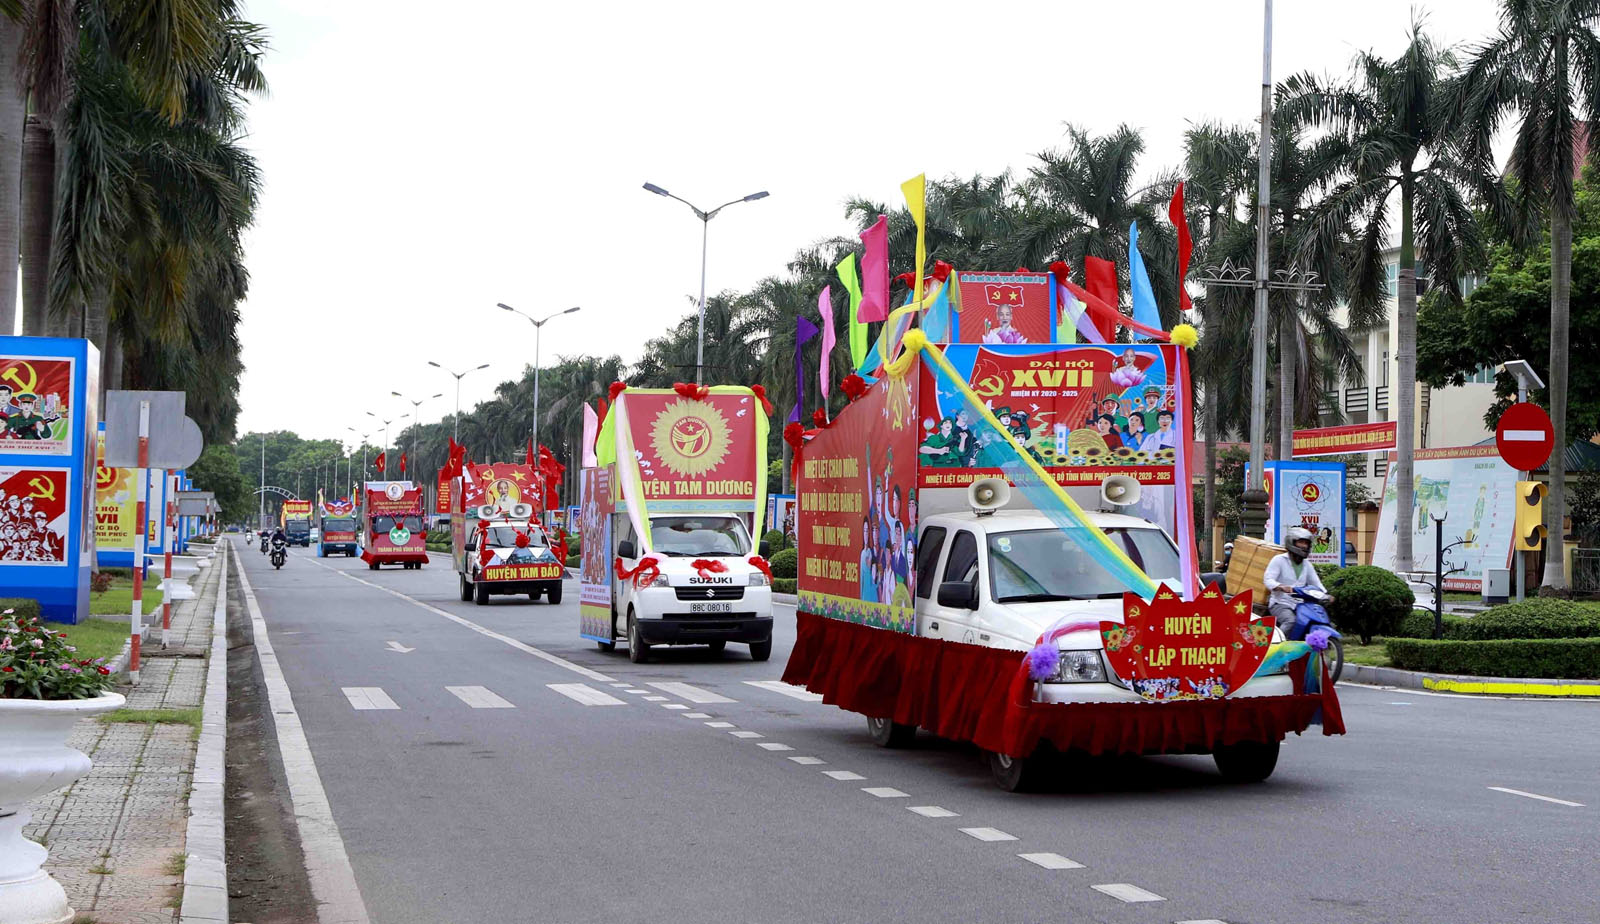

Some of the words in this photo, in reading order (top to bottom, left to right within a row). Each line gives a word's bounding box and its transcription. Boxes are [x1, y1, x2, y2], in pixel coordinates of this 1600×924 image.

[1029, 361, 1060, 370] ĐẠI
[1065, 359, 1094, 370] HỘI
[1011, 369, 1094, 388] XVII
[1010, 390, 1030, 398] NHIỆM
[676, 418, 688, 428] TAM
[804, 456, 818, 483] NHIỆT
[818, 456, 828, 483] LIỆT
[828, 455, 842, 479] CHÀO
[843, 454, 858, 479] MỪNG
[926, 473, 942, 486] NHIỆT
[944, 473, 956, 486] LIỆT
[957, 472, 973, 483] CHÀO
[1056, 471, 1064, 483] BỘ
[1066, 470, 1079, 481] TỈNH
[1080, 471, 1094, 481] VĨNH
[1138, 472, 1152, 480] 2020
[1156, 471, 1170, 480] 2025
[643, 478, 670, 498] YỆN
[674, 480, 702, 496] TAM
[706, 480, 753, 496] DƯƠNG
[802, 492, 810, 516] ĐẠI
[810, 489, 818, 516] HỘI
[818, 492, 828, 516] ĐẠI
[828, 485, 840, 513] BIỂU
[840, 486, 855, 513] ĐẢNG
[855, 489, 862, 517] BỘ
[96, 513, 118, 524] VII
[1301, 516, 1319, 524] XVII
[812, 519, 824, 545] TỈNH
[824, 522, 836, 546] VĨNH
[836, 523, 850, 548] PHÚC
[486, 566, 517, 580] HUYỆN
[520, 567, 538, 578] TAM
[541, 563, 560, 578] ĐẢO
[806, 554, 822, 581] NHIỆM
[822, 555, 828, 578] KỲ
[830, 560, 842, 580] 2020
[846, 562, 858, 582] 2025
[692, 603, 705, 612] 88C
[1164, 612, 1212, 639] HUYỆN
[1149, 644, 1176, 671] LẬP
[1181, 646, 1226, 671] THẠCH
